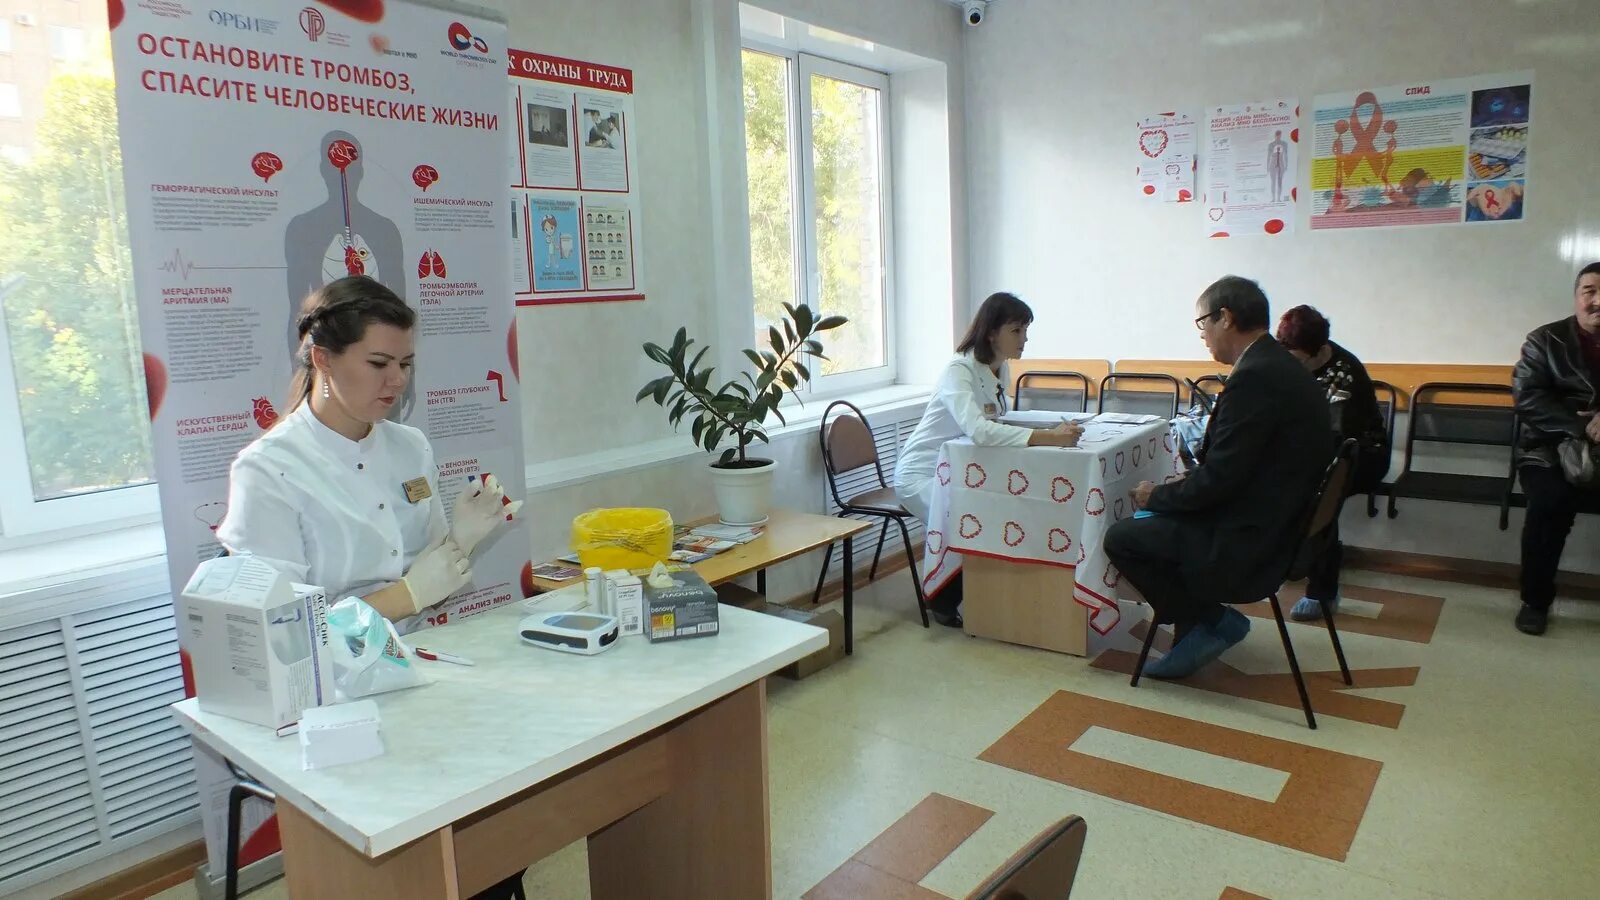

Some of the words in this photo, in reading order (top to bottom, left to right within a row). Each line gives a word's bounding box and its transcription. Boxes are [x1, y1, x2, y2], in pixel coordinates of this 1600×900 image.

[208, 9, 260, 32] ОРБИ
[137, 33, 305, 77] ОСТАНОВИТЕ
[311, 59, 416, 95] ТРОМБОЗ,
[522, 57, 582, 80] ОХРАНЫ
[587, 68, 627, 88] ТРУДА
[1405, 85, 1431, 96] СПИД
[141, 69, 258, 103] СПАСИТЕ
[264, 85, 427, 123] ЧЕЛОВЕЧЕСКИЕ
[432, 106, 499, 131] ЖИЗНИ
[151, 184, 240, 196] ГЕМОРРАГИЧЕСКИЙ
[242, 189, 279, 197] ИНСУЛЬТ
[414, 197, 465, 206] ИШЕМИЧЕСКИЙ
[161, 286, 233, 297] МЕРЦАТЕЛЬНАЯ
[419, 282, 478, 290] ТРОМБОЭМБОЛИЯ
[420, 289, 455, 297] ЛЕГОЧНОЙ
[456, 289, 484, 297] АРТЕРИИ
[163, 297, 209, 305] АРИТМИЯ
[210, 295, 230, 305] (МА)
[420, 298, 441, 306] (ТЭЛА)
[427, 388, 457, 397] ТРОМБОЗ
[457, 385, 491, 395] ГЛУБОКИХ
[427, 398, 440, 406] ВЕН
[440, 396, 456, 404] (ТГВ)
[176, 411, 251, 427] ИСКУССТВЕННЫЙ
[178, 425, 215, 436] КЛАПАН
[216, 420, 248, 432] СЕРДЦА
[445, 458, 478, 469] ВЕНОЗНАЯ
[458, 599, 491, 614] АНАЛИЗ
[493, 593, 512, 604] МНО
[317, 593, 329, 647] ACCU-CHEK
